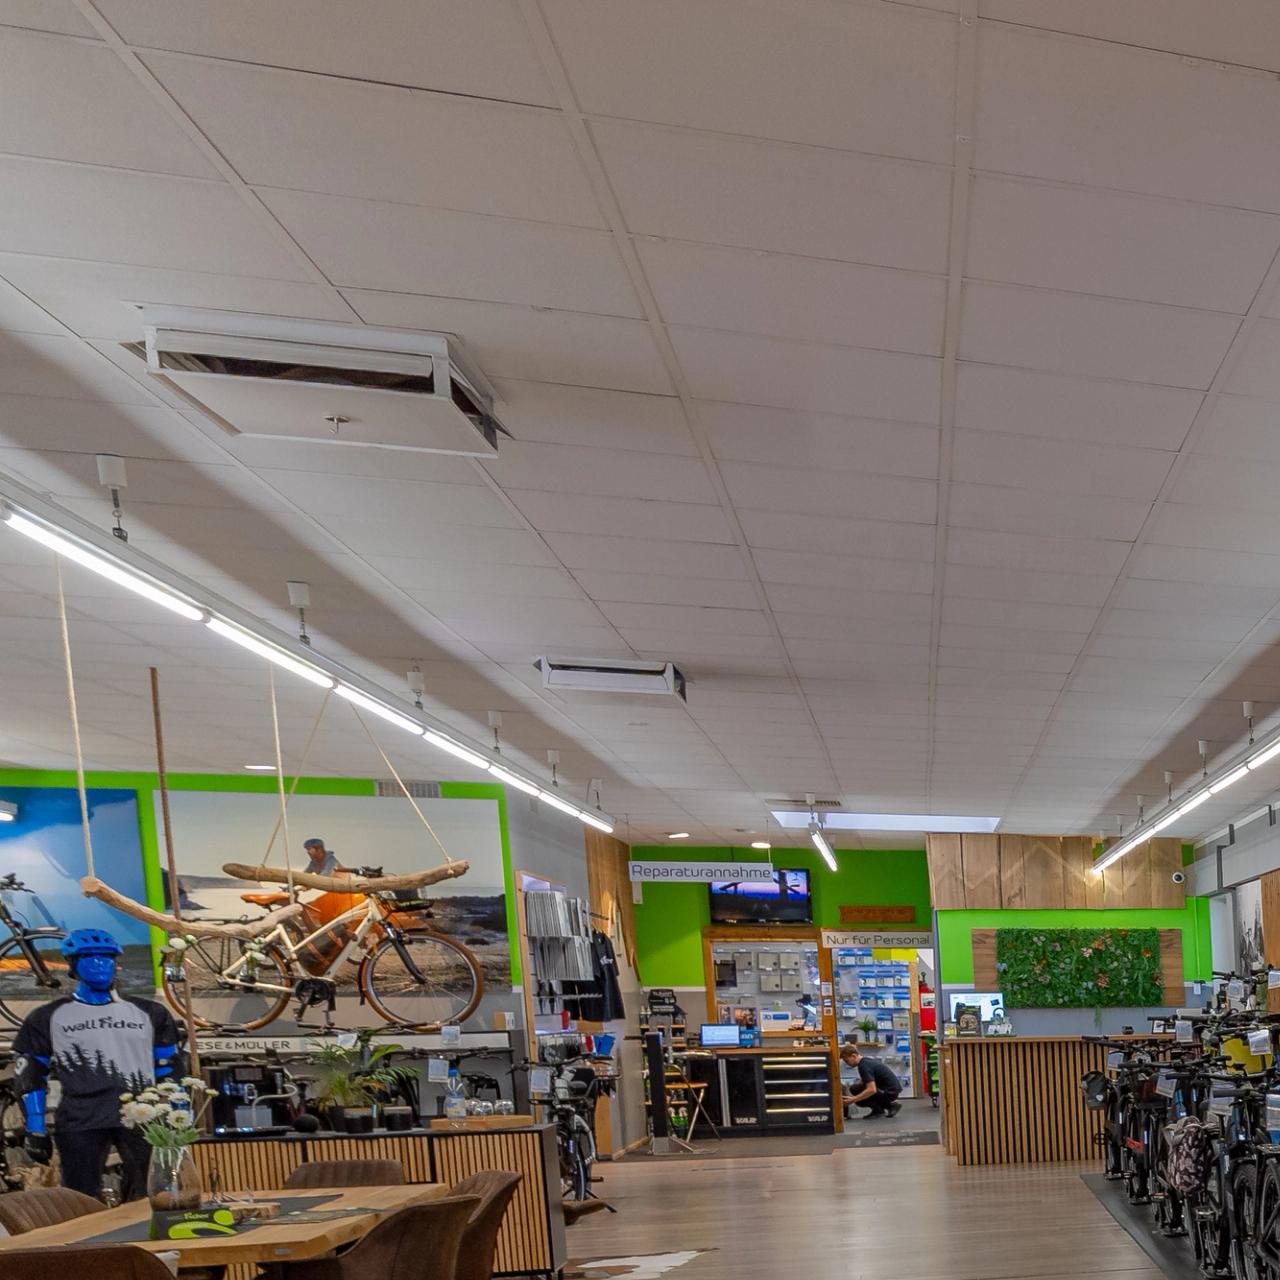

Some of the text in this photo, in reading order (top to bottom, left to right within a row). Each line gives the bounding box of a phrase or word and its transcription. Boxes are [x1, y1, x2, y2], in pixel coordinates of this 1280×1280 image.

[631, 864, 771, 879] Reparaturannahme
[826, 935, 930, 945] Nur für Personal
[234, 1039, 291, 1050] MÜLLER
